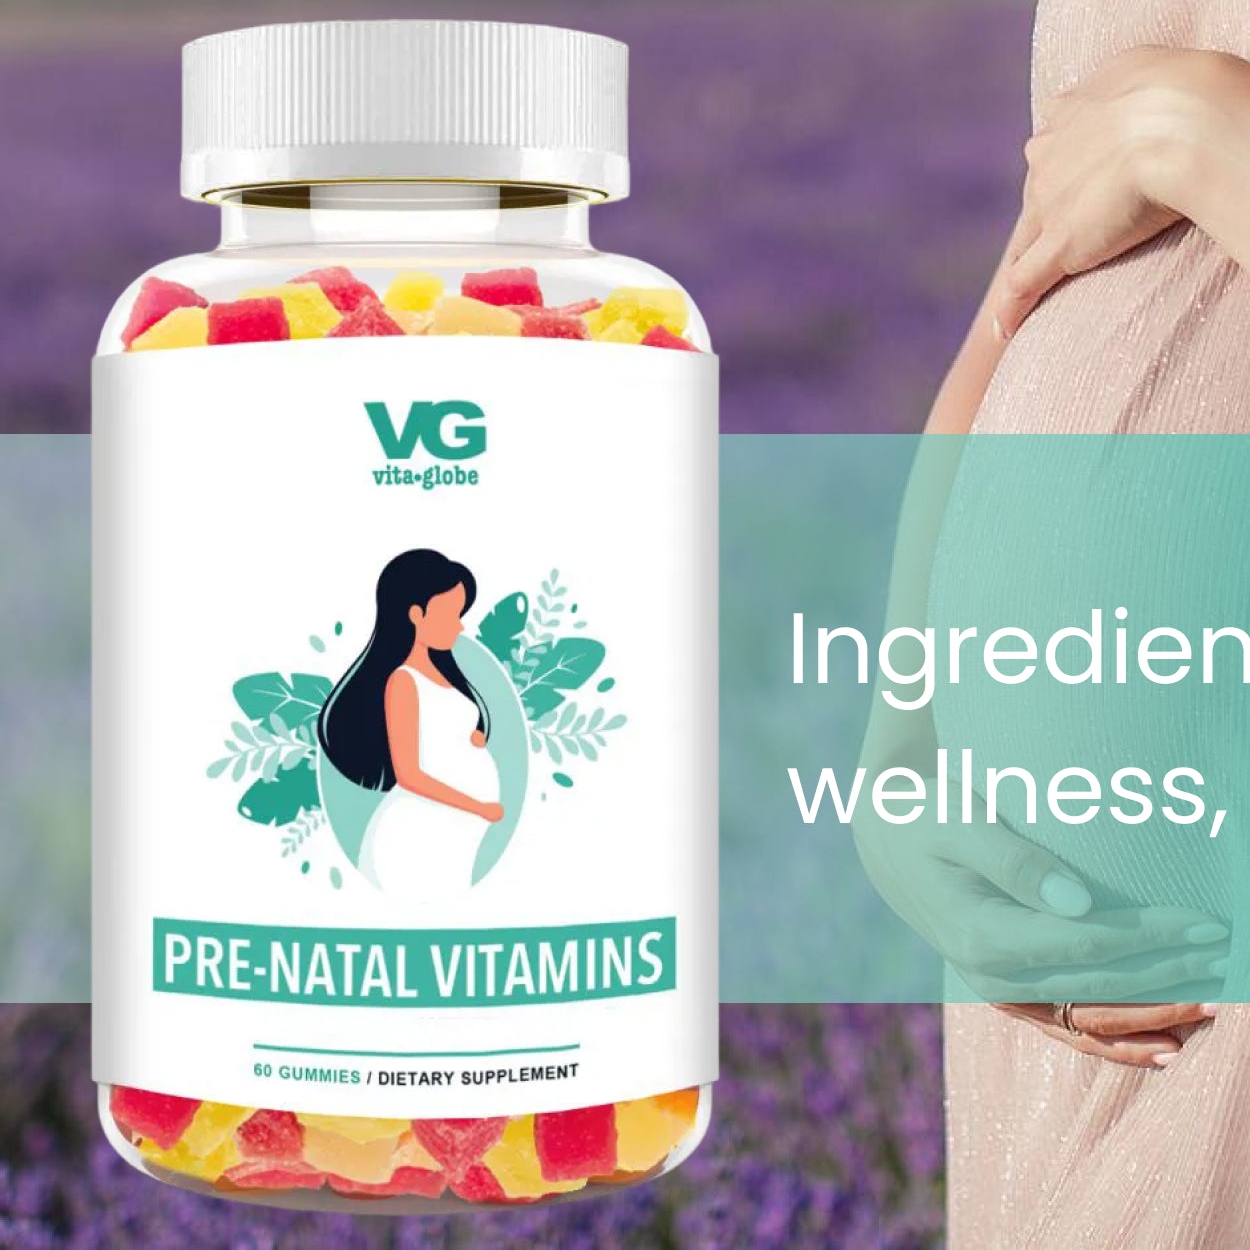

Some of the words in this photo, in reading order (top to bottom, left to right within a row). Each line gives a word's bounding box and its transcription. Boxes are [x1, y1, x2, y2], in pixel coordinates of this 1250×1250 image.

[363, 399, 488, 461] VG
[164, 932, 419, 998] PRE-NATAL
[430, 930, 665, 998] VITAMINS
[253, 1062, 273, 1078] 60
[278, 1065, 361, 1084] GUMMIES
[378, 1070, 455, 1086] DIETARY
[461, 1062, 579, 1086] SUPPLEMENT
